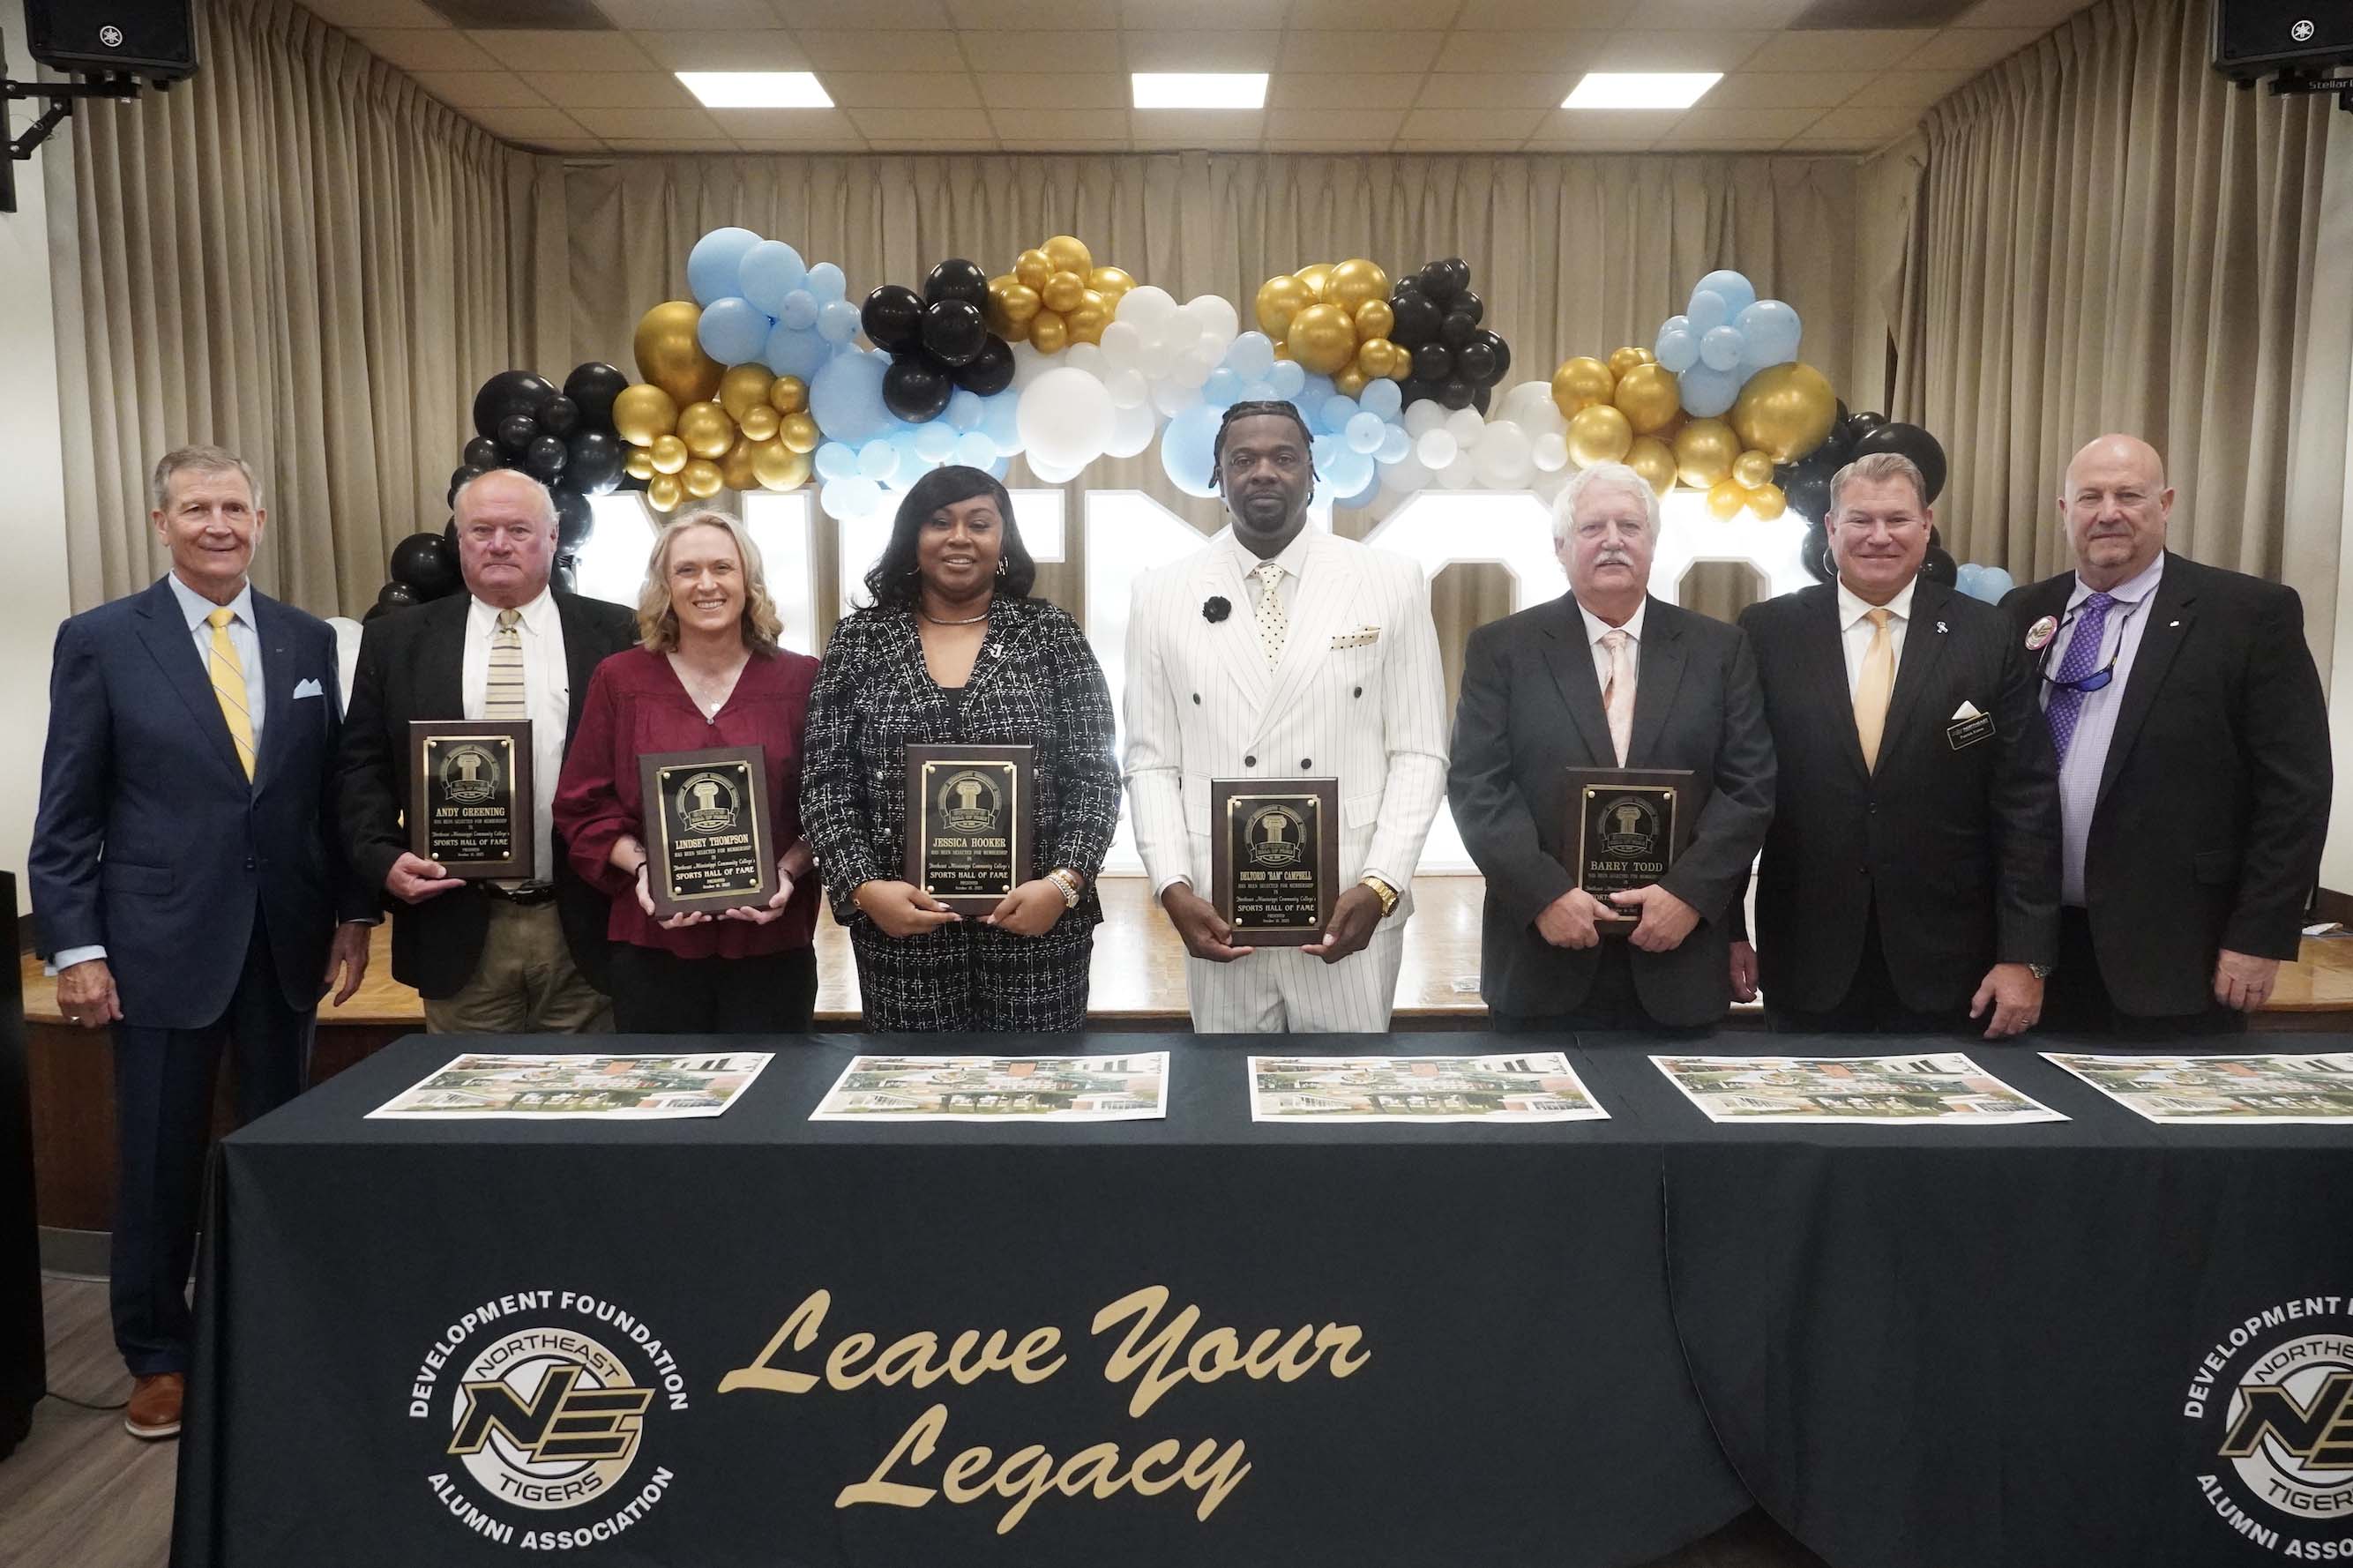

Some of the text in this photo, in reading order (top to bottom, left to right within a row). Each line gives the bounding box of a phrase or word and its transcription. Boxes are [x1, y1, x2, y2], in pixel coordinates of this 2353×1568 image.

[436, 807, 505, 818] ANDY GREENING
[675, 833, 749, 850] LINDSEY THOMPSON
[933, 838, 1005, 847] JESSICA HOOKER
[676, 871, 702, 880] SPORTS
[704, 870, 722, 878] HALL
[1284, 871, 1312, 880] CAMPBELL
[1591, 861, 1663, 872] BARRY TODD
[409, 1291, 689, 1418] DEVELOPMENT FOUNDATION
[474, 1335, 621, 1378] NORTHEAST
[718, 1285, 1371, 1418] Leave Your
[2184, 1296, 2341, 1418] DEVELOPMENT
[447, 1364, 656, 1464] NE
[499, 1470, 603, 1502] TIGERS
[834, 1403, 1252, 1535] Legacy
[428, 1466, 674, 1550] ALUMNI ASSOCIATION
[2197, 1474, 2280, 1550] ALUMNI
